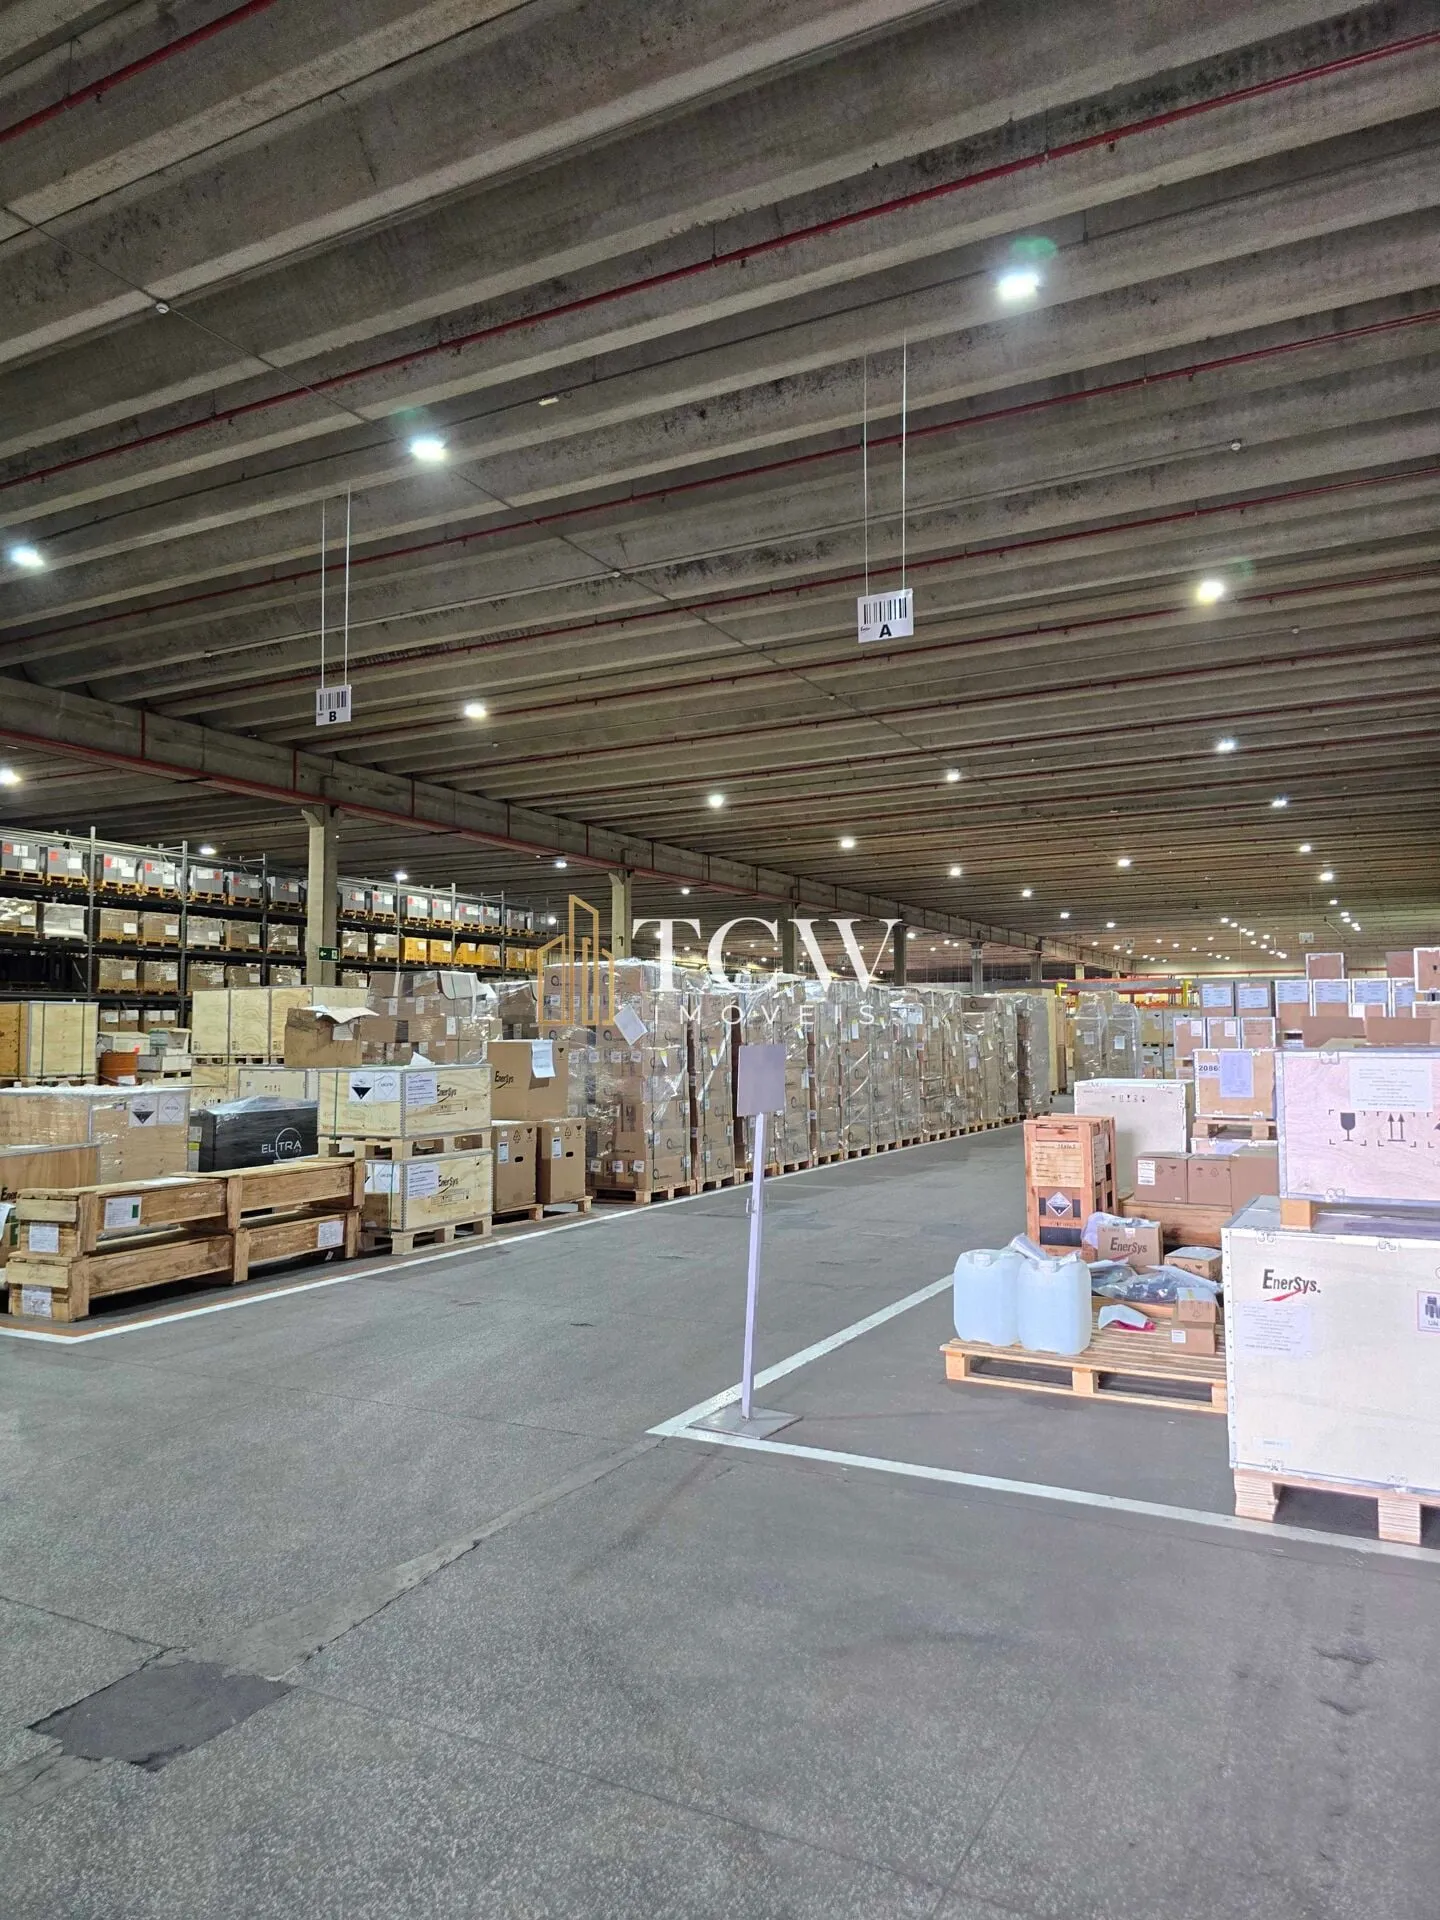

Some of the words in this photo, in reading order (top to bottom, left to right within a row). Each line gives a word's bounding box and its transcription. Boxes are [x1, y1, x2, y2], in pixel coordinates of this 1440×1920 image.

[879, 624, 892, 638] A
[329, 711, 337, 722] B
[1110, 1237, 1148, 1254] EnerSys
